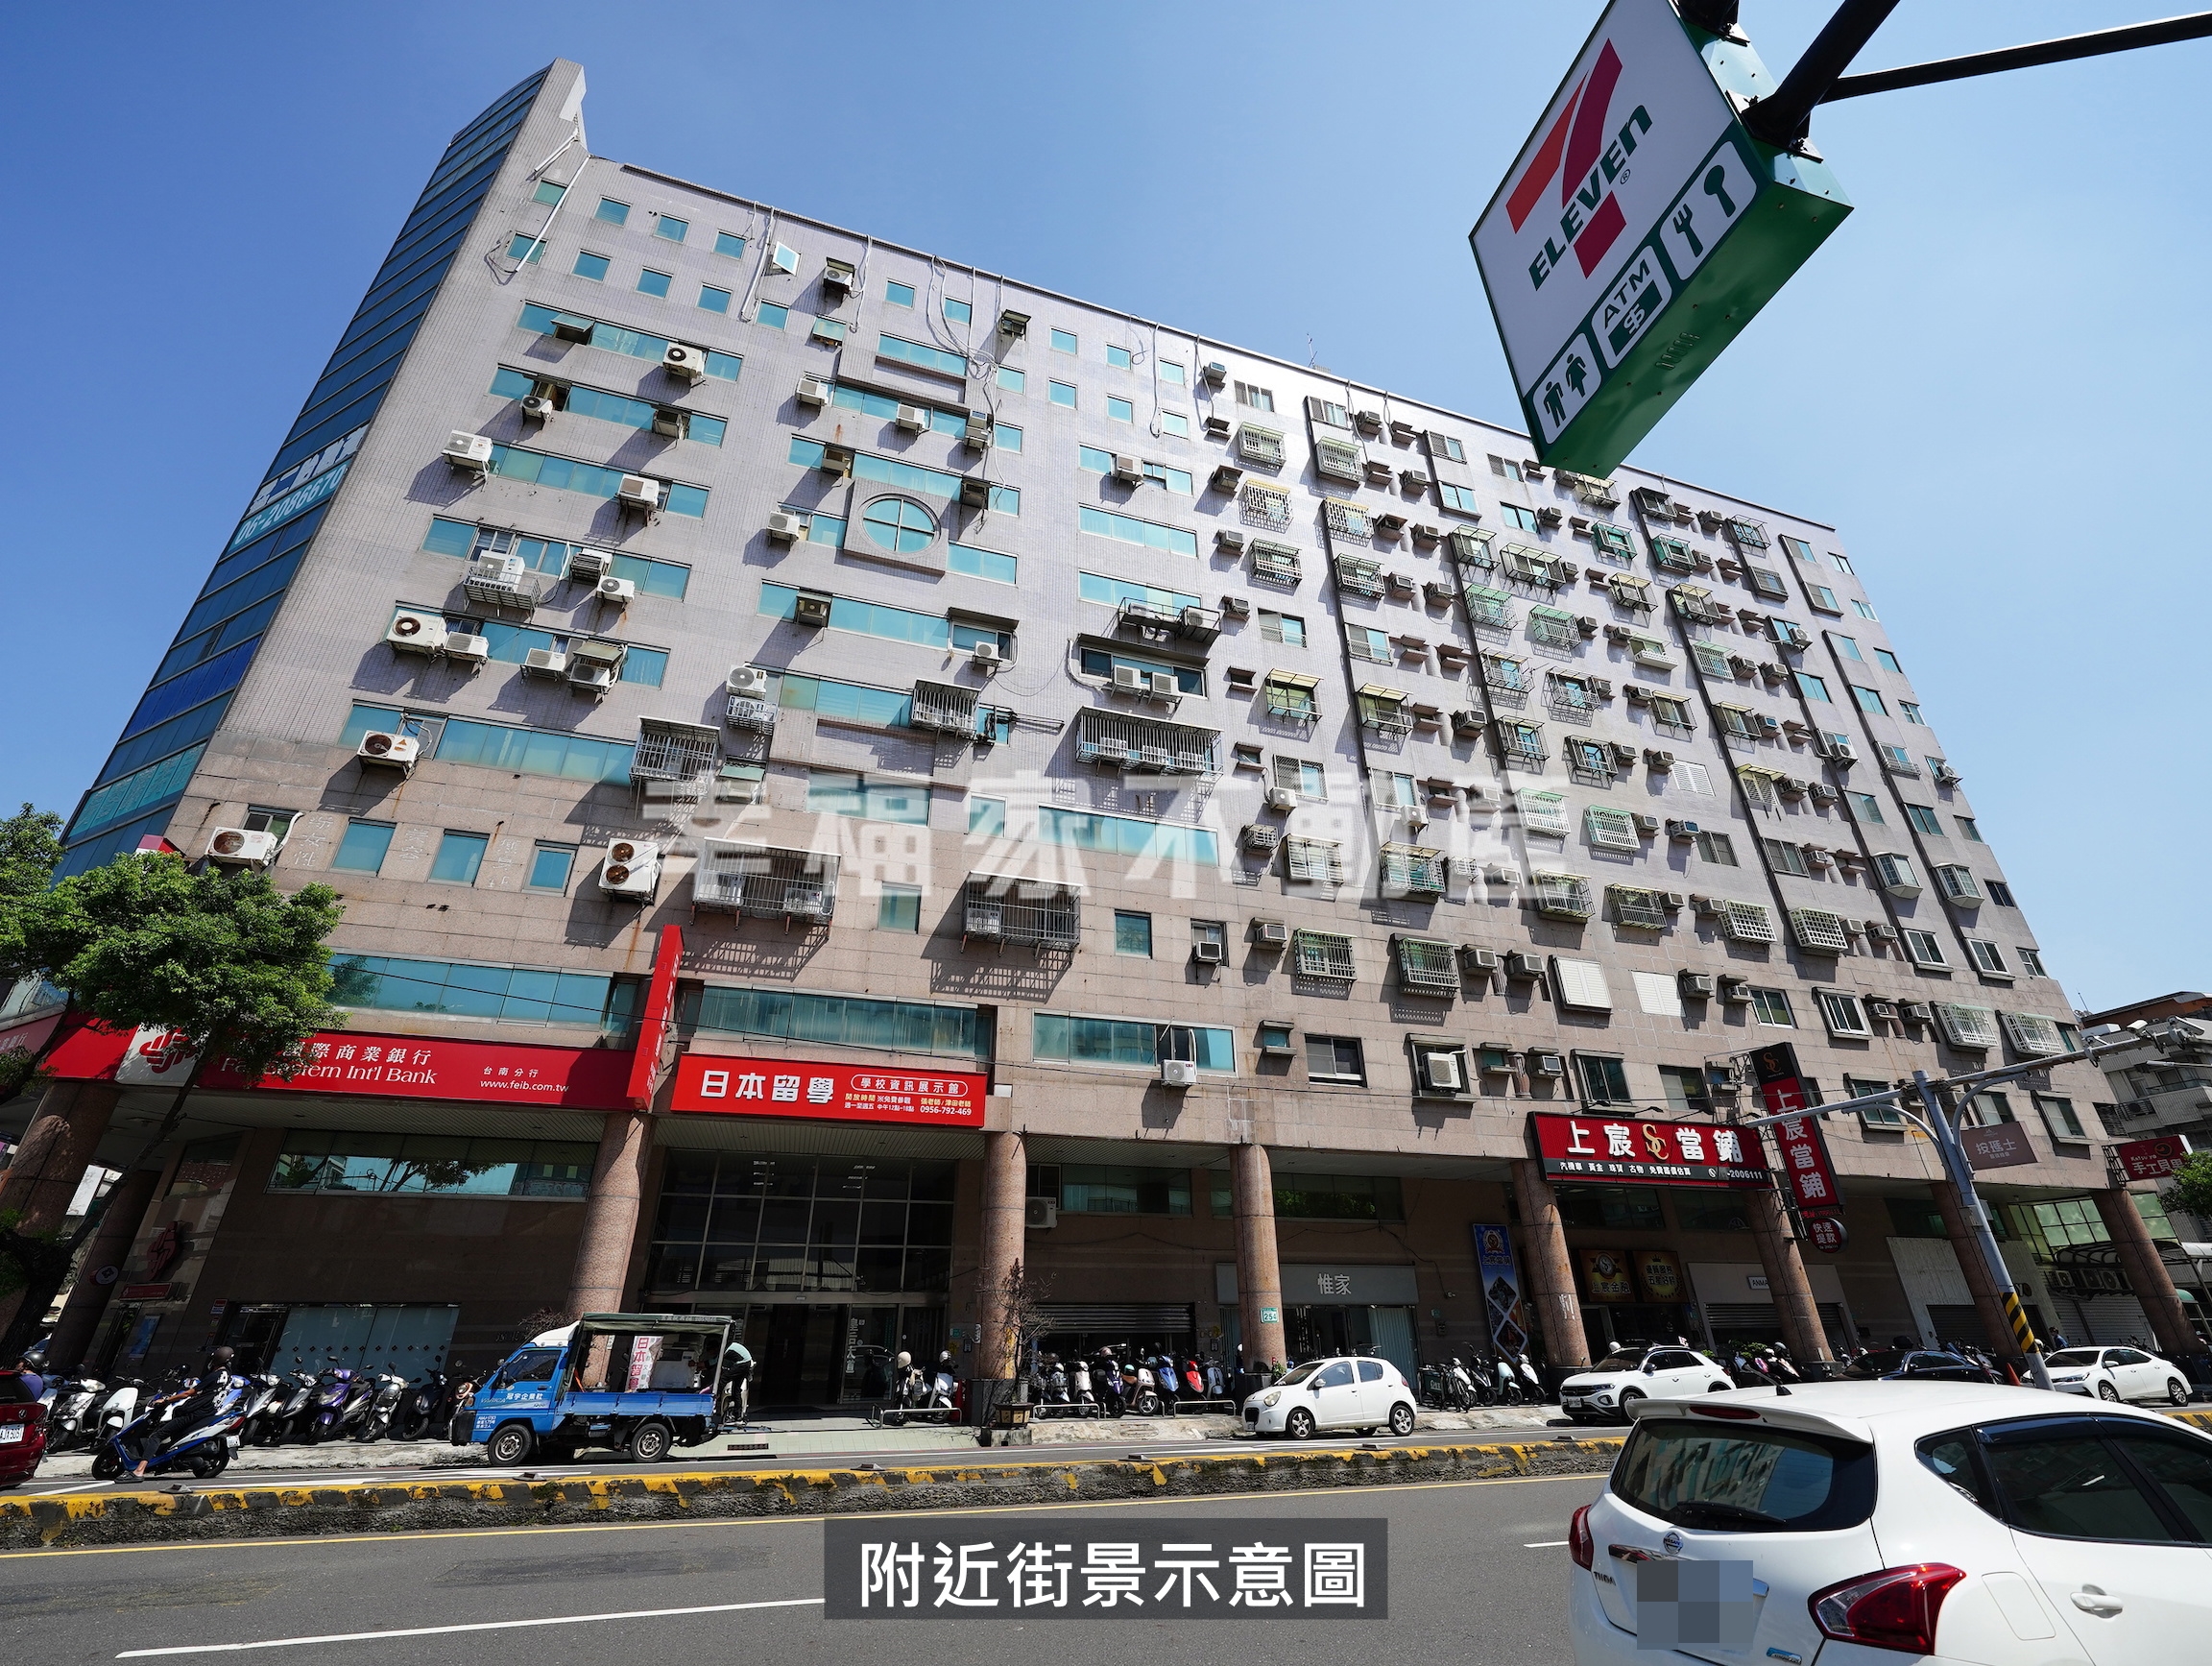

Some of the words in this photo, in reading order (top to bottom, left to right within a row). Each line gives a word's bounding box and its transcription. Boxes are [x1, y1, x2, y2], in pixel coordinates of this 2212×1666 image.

[1602, 261, 1650, 329] ATM
[234, 463, 347, 545] 06-2086670
[346, 1065, 382, 1081] Int'l
[385, 1068, 438, 1085] Bank
[483, 1066, 540, 1078] 台南分行
[480, 1079, 569, 1092] www.feib.com.tw
[700, 1069, 835, 1104] 日本留學
[860, 1076, 959, 1095] 學校資訊展示館
[919, 1105, 973, 1116] 0956-792-469
[1317, 1272, 1352, 1295] 惟家
